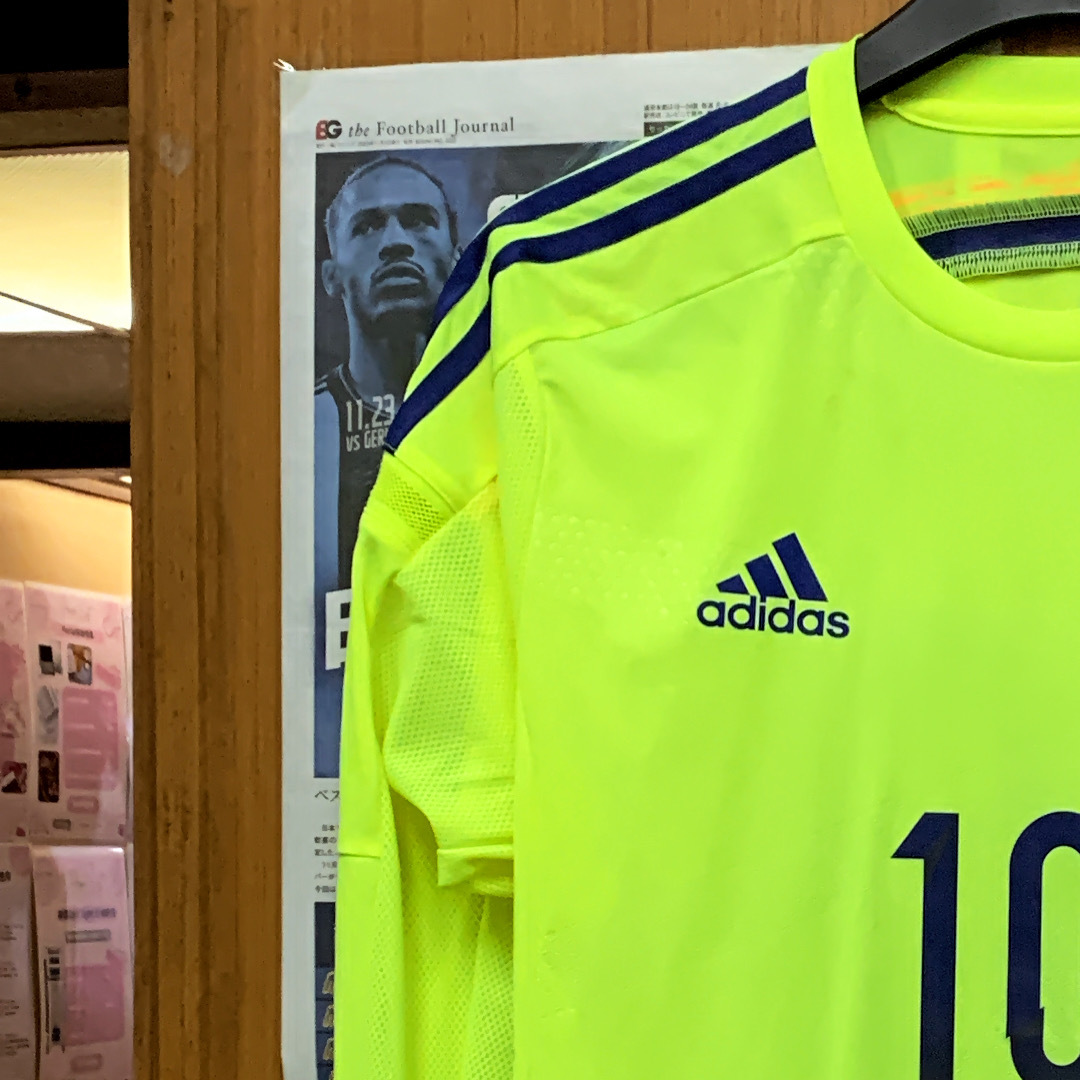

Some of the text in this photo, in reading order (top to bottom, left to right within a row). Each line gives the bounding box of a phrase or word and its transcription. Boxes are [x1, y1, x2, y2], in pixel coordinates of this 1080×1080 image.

[349, 122, 370, 138] the
[376, 118, 446, 137] Football
[451, 116, 515, 137] Journal
[345, 393, 395, 432] 11.23
[346, 434, 361, 452] VS
[696, 594, 850, 638] adidas
